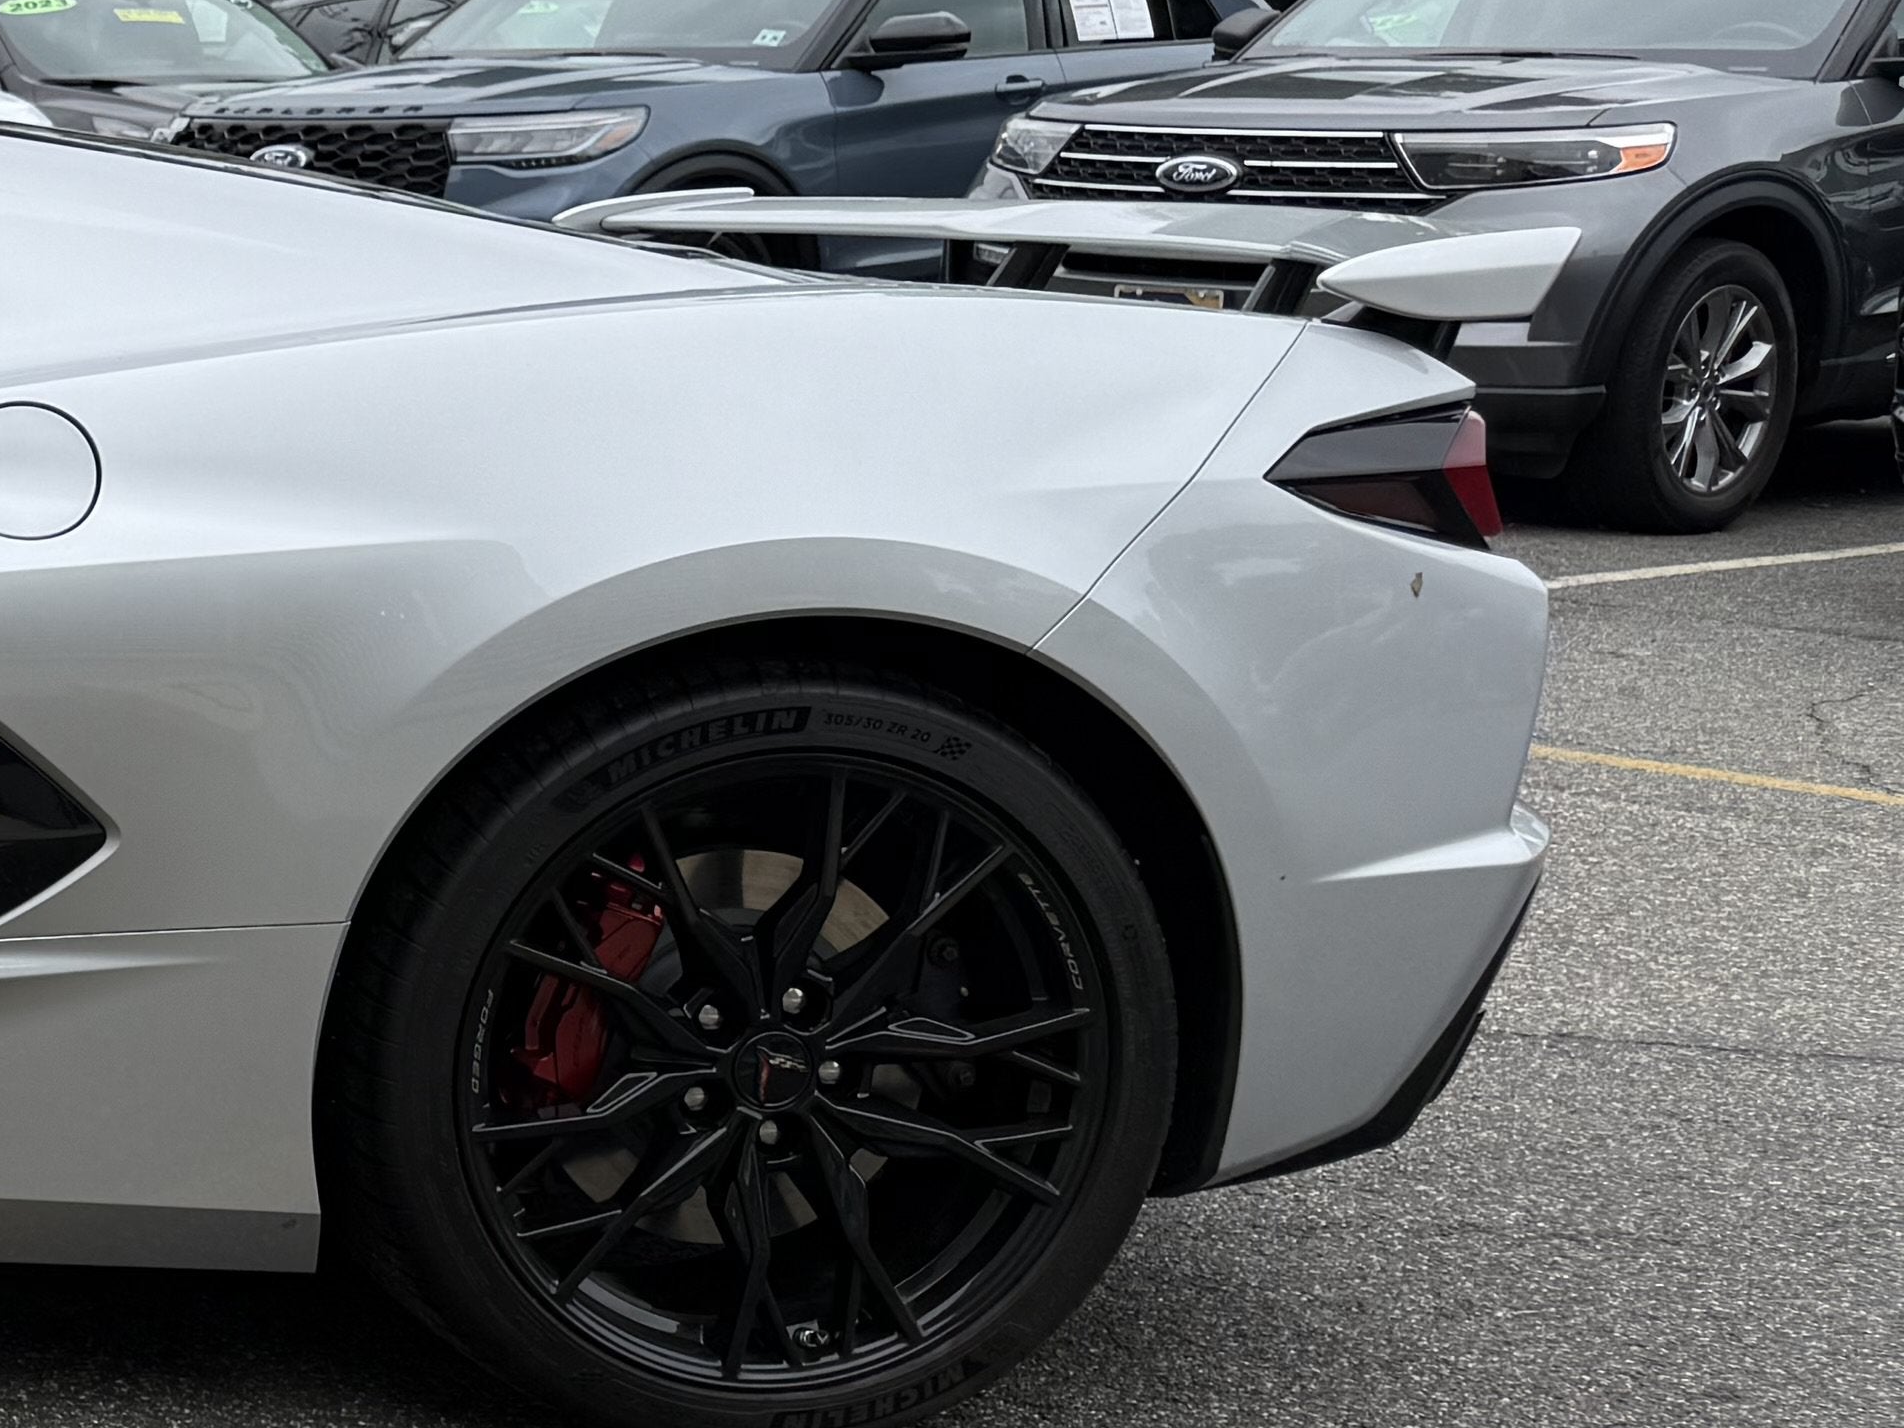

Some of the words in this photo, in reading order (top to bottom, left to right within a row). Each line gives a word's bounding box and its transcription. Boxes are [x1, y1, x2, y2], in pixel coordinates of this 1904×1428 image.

[1172, 162, 1217, 183] Ford
[607, 709, 799, 783] MICHELIN
[824, 711, 884, 732] 305/30
[887, 721, 909, 736] ZR
[910, 728, 932, 743] 20
[1016, 872, 1085, 991] CORVETTE
[471, 988, 494, 1095] FORGED
